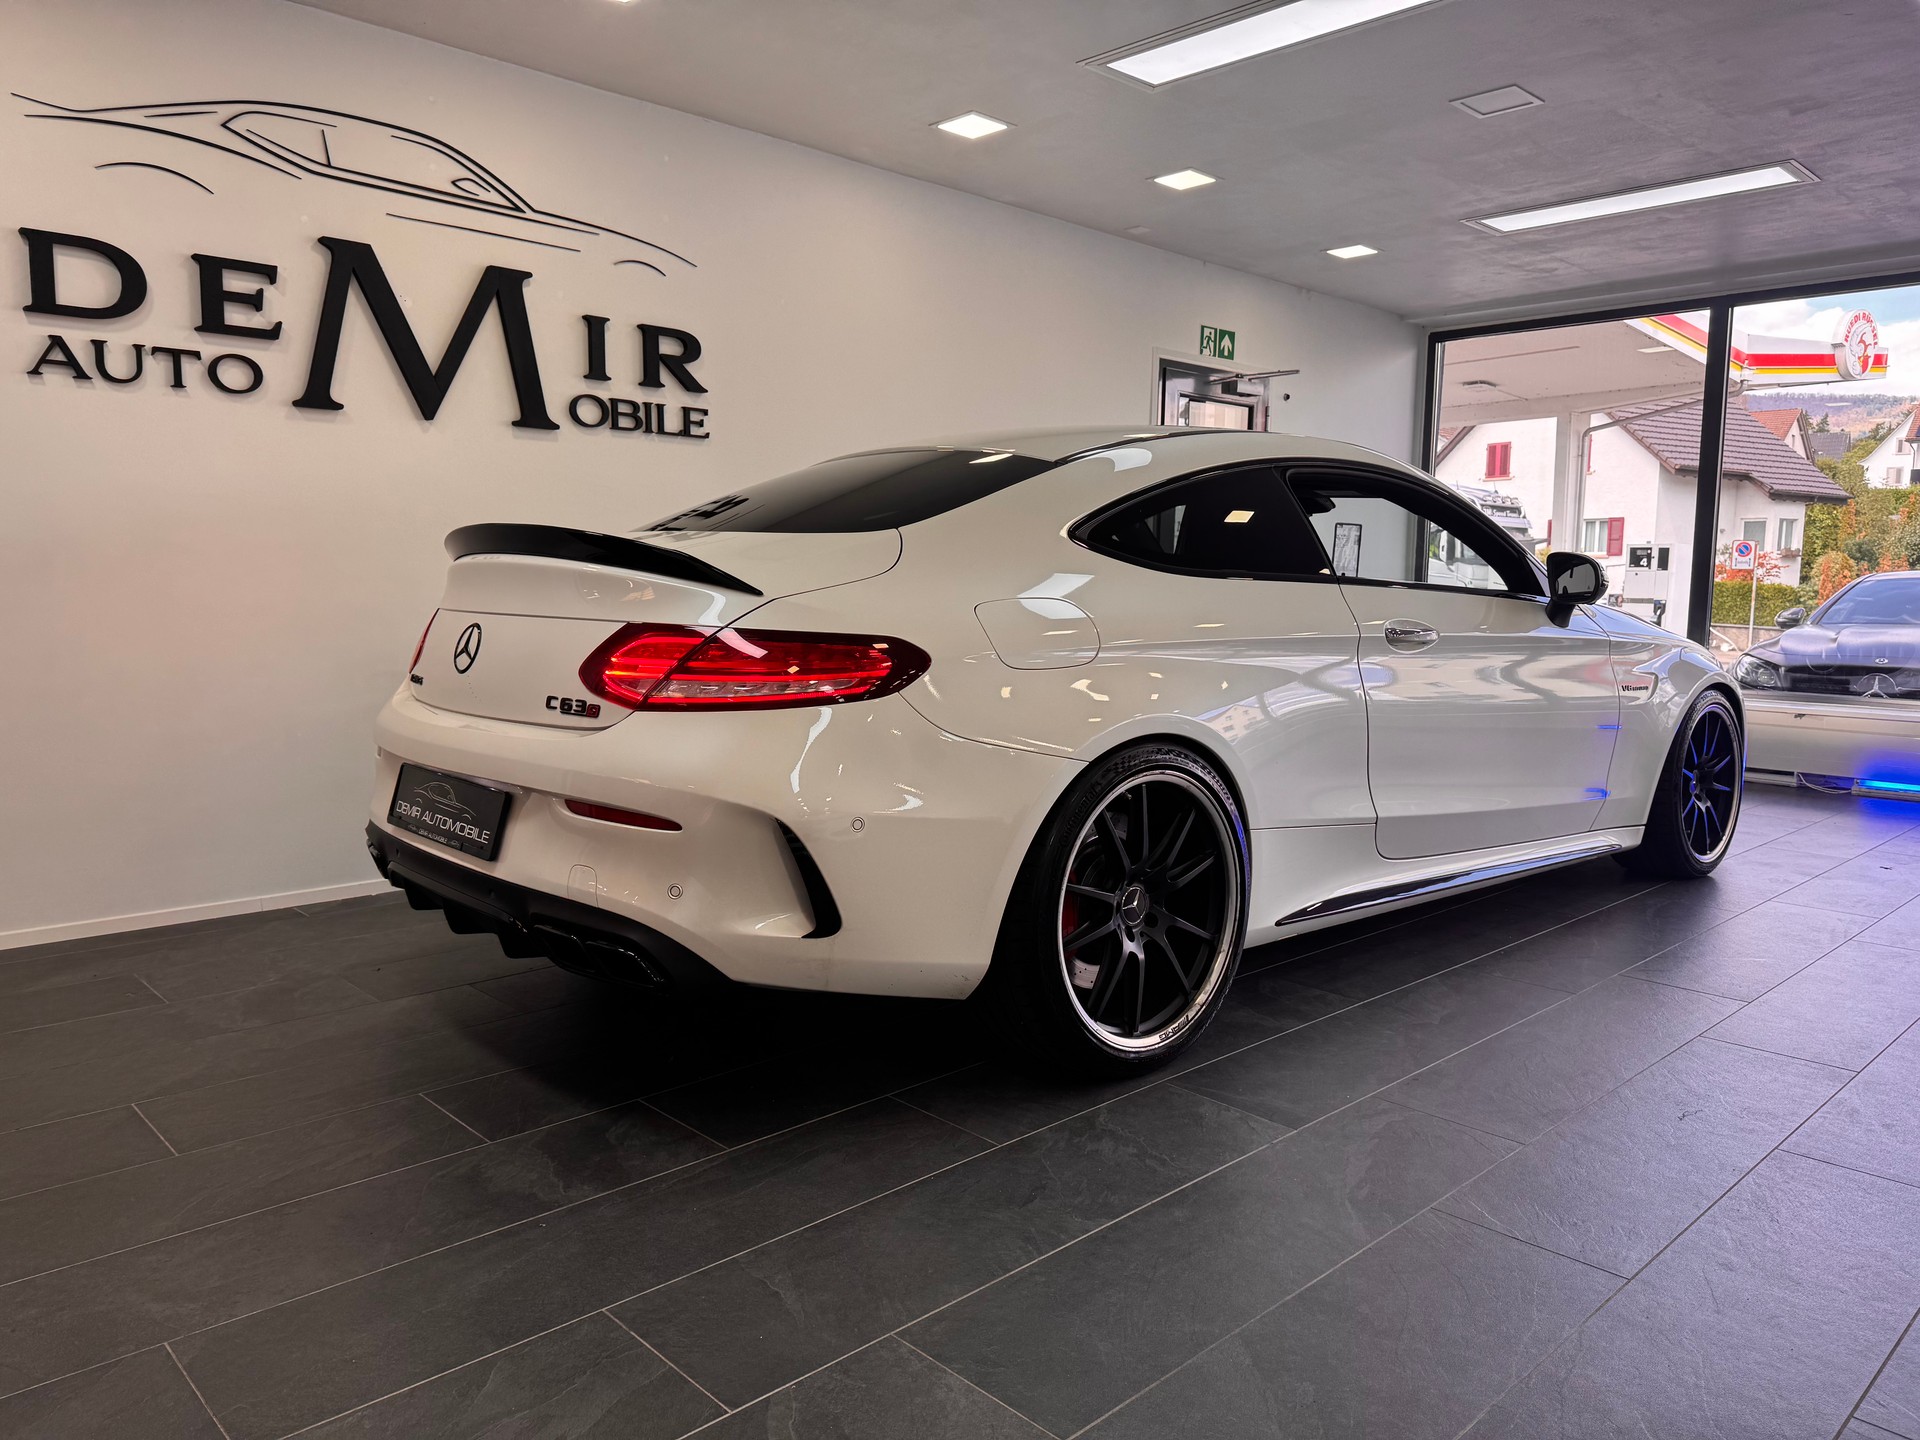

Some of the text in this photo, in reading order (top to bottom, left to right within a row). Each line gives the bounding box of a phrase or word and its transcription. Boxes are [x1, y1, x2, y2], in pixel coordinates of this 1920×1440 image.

[1844, 312, 1861, 343] RUEDI
[1640, 557, 1648, 567] 4
[396, 800, 490, 844] DEMIR AUTOMOBILE
